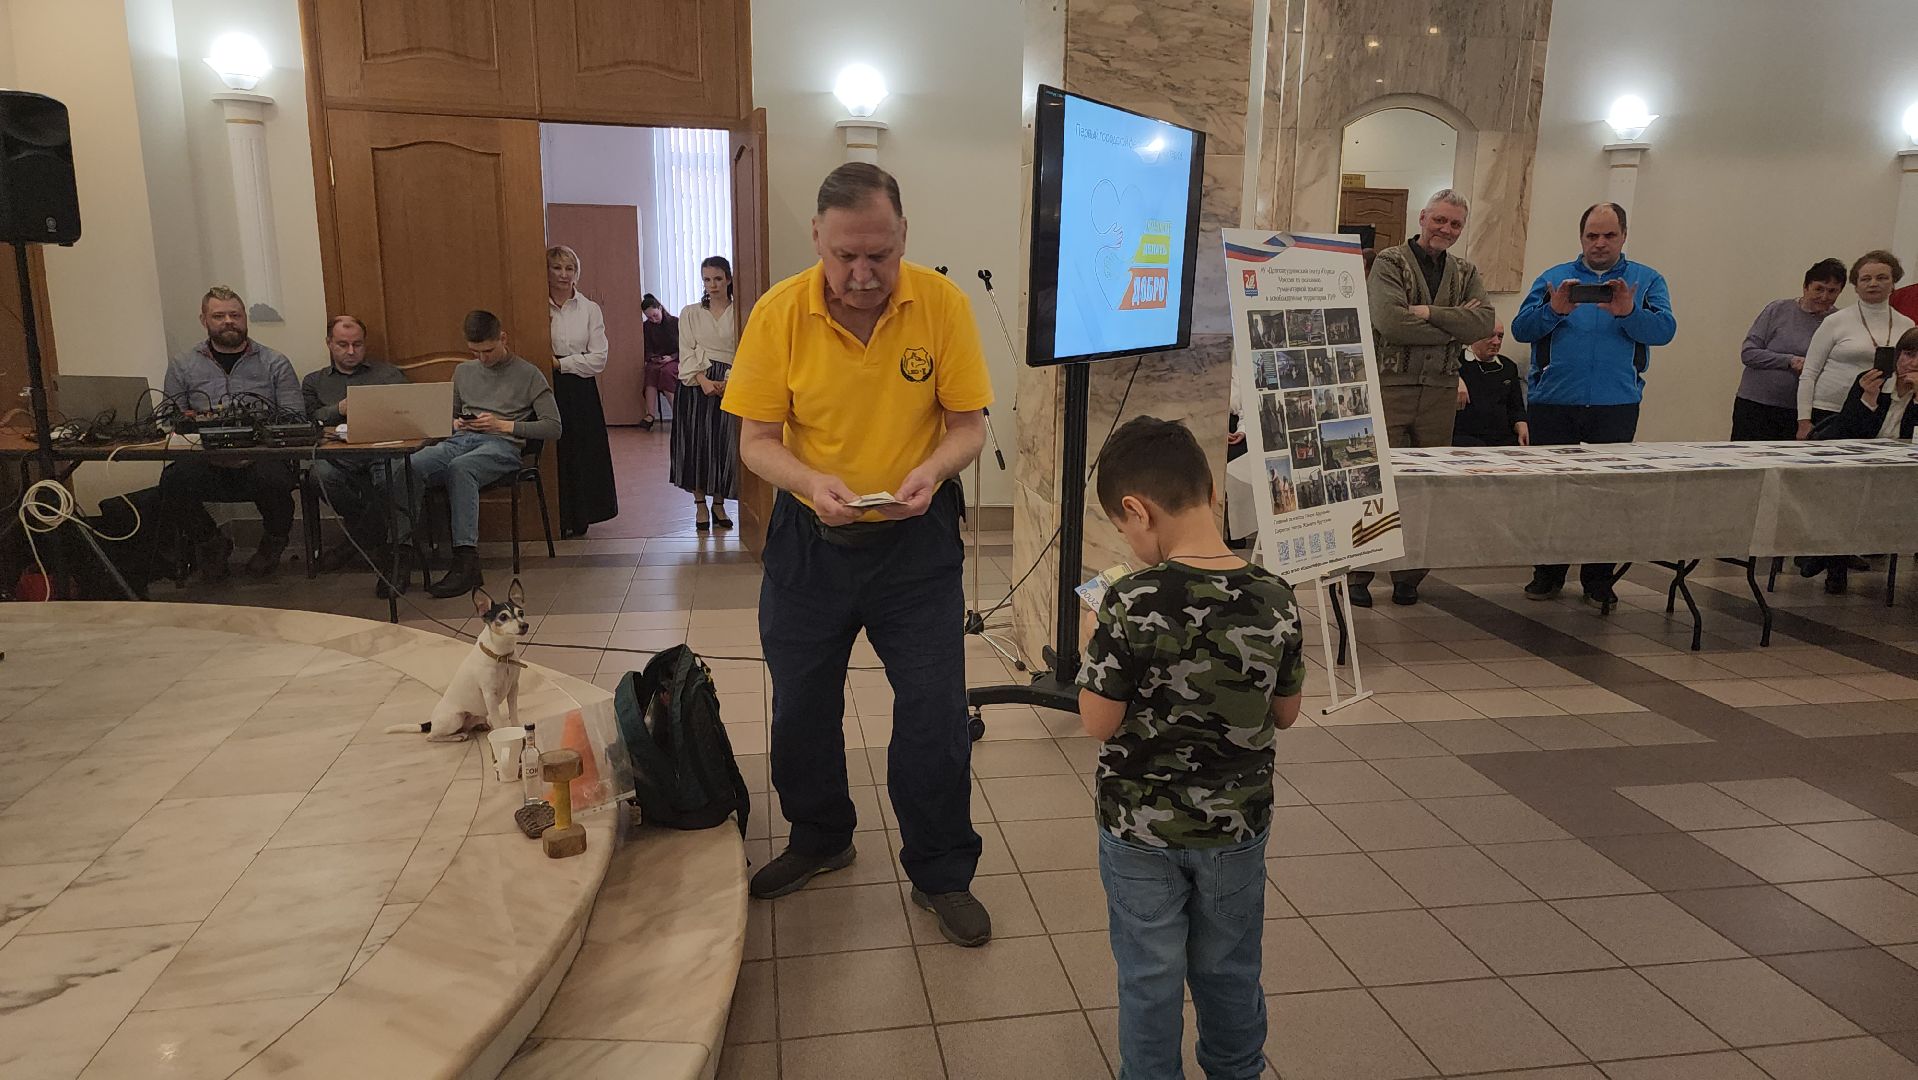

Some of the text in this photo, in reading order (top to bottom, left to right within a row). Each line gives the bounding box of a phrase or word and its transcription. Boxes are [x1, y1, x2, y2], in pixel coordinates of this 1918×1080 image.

[1132, 276, 1166, 306] ДОБРО
[1362, 498, 1384, 517] ZV
[1080, 588, 1099, 607] 2000
